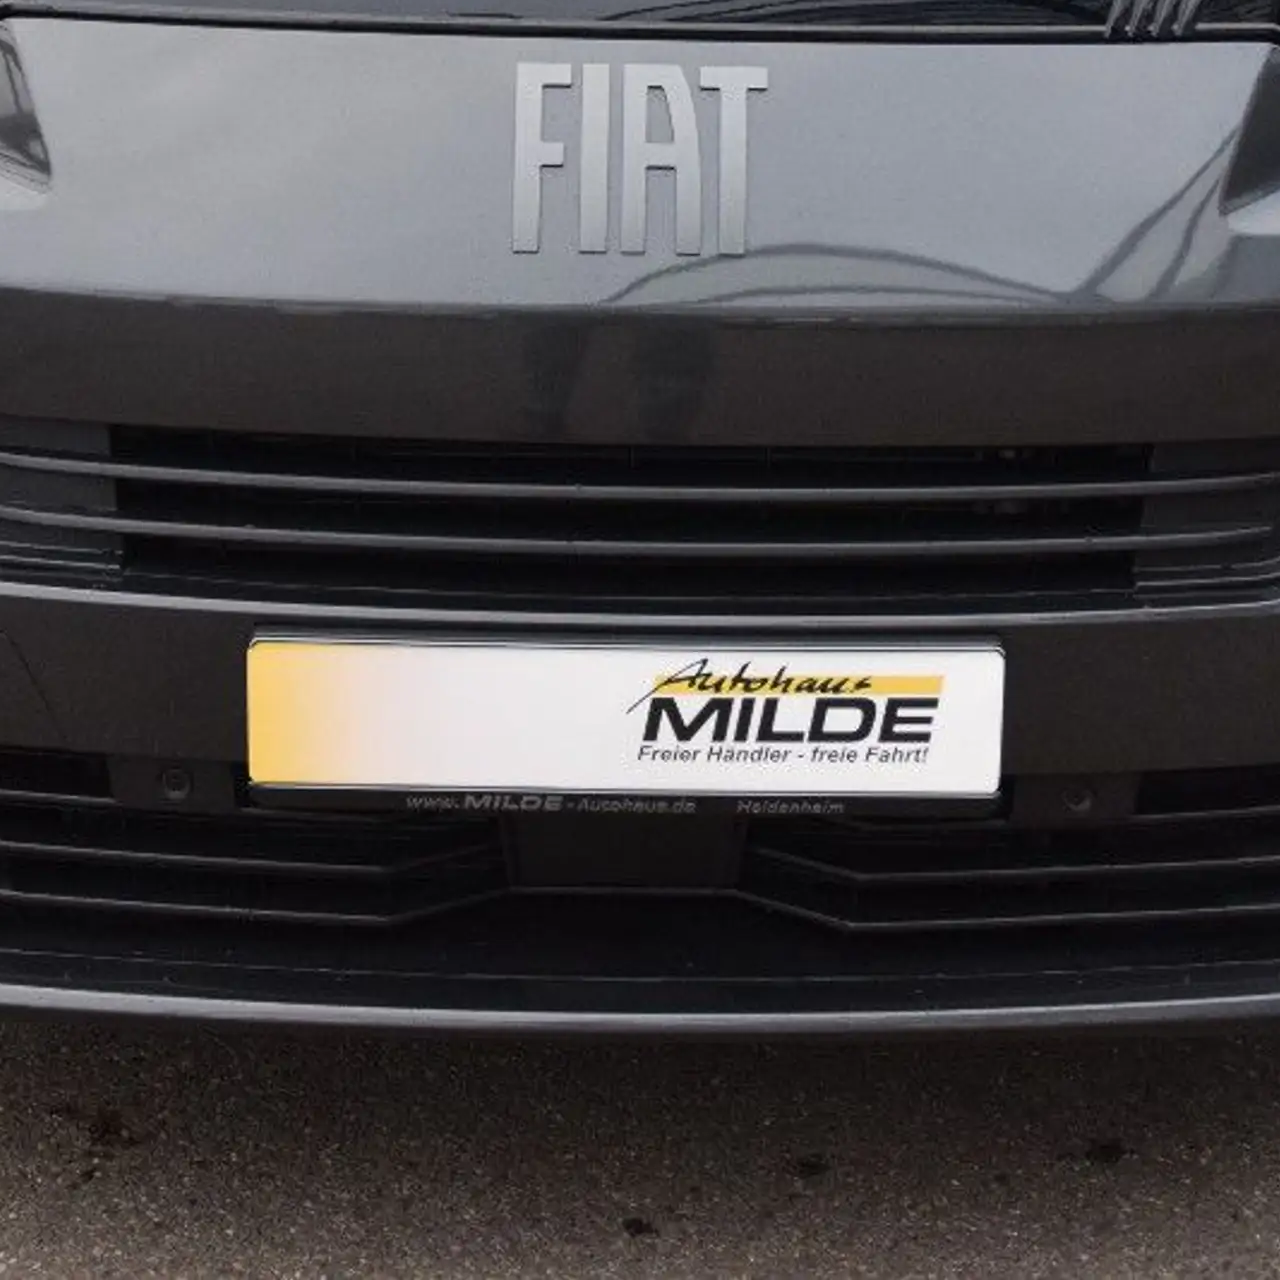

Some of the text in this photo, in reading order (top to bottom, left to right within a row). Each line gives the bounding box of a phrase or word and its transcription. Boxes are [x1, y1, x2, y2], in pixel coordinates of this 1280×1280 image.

[512, 63, 768, 256] FIAT
[626, 657, 873, 715] Autohaus
[642, 697, 940, 743] MILDE
[637, 744, 701, 763] Freier
[811, 745, 858, 764] freie
[865, 746, 929, 765] Fahrt!
